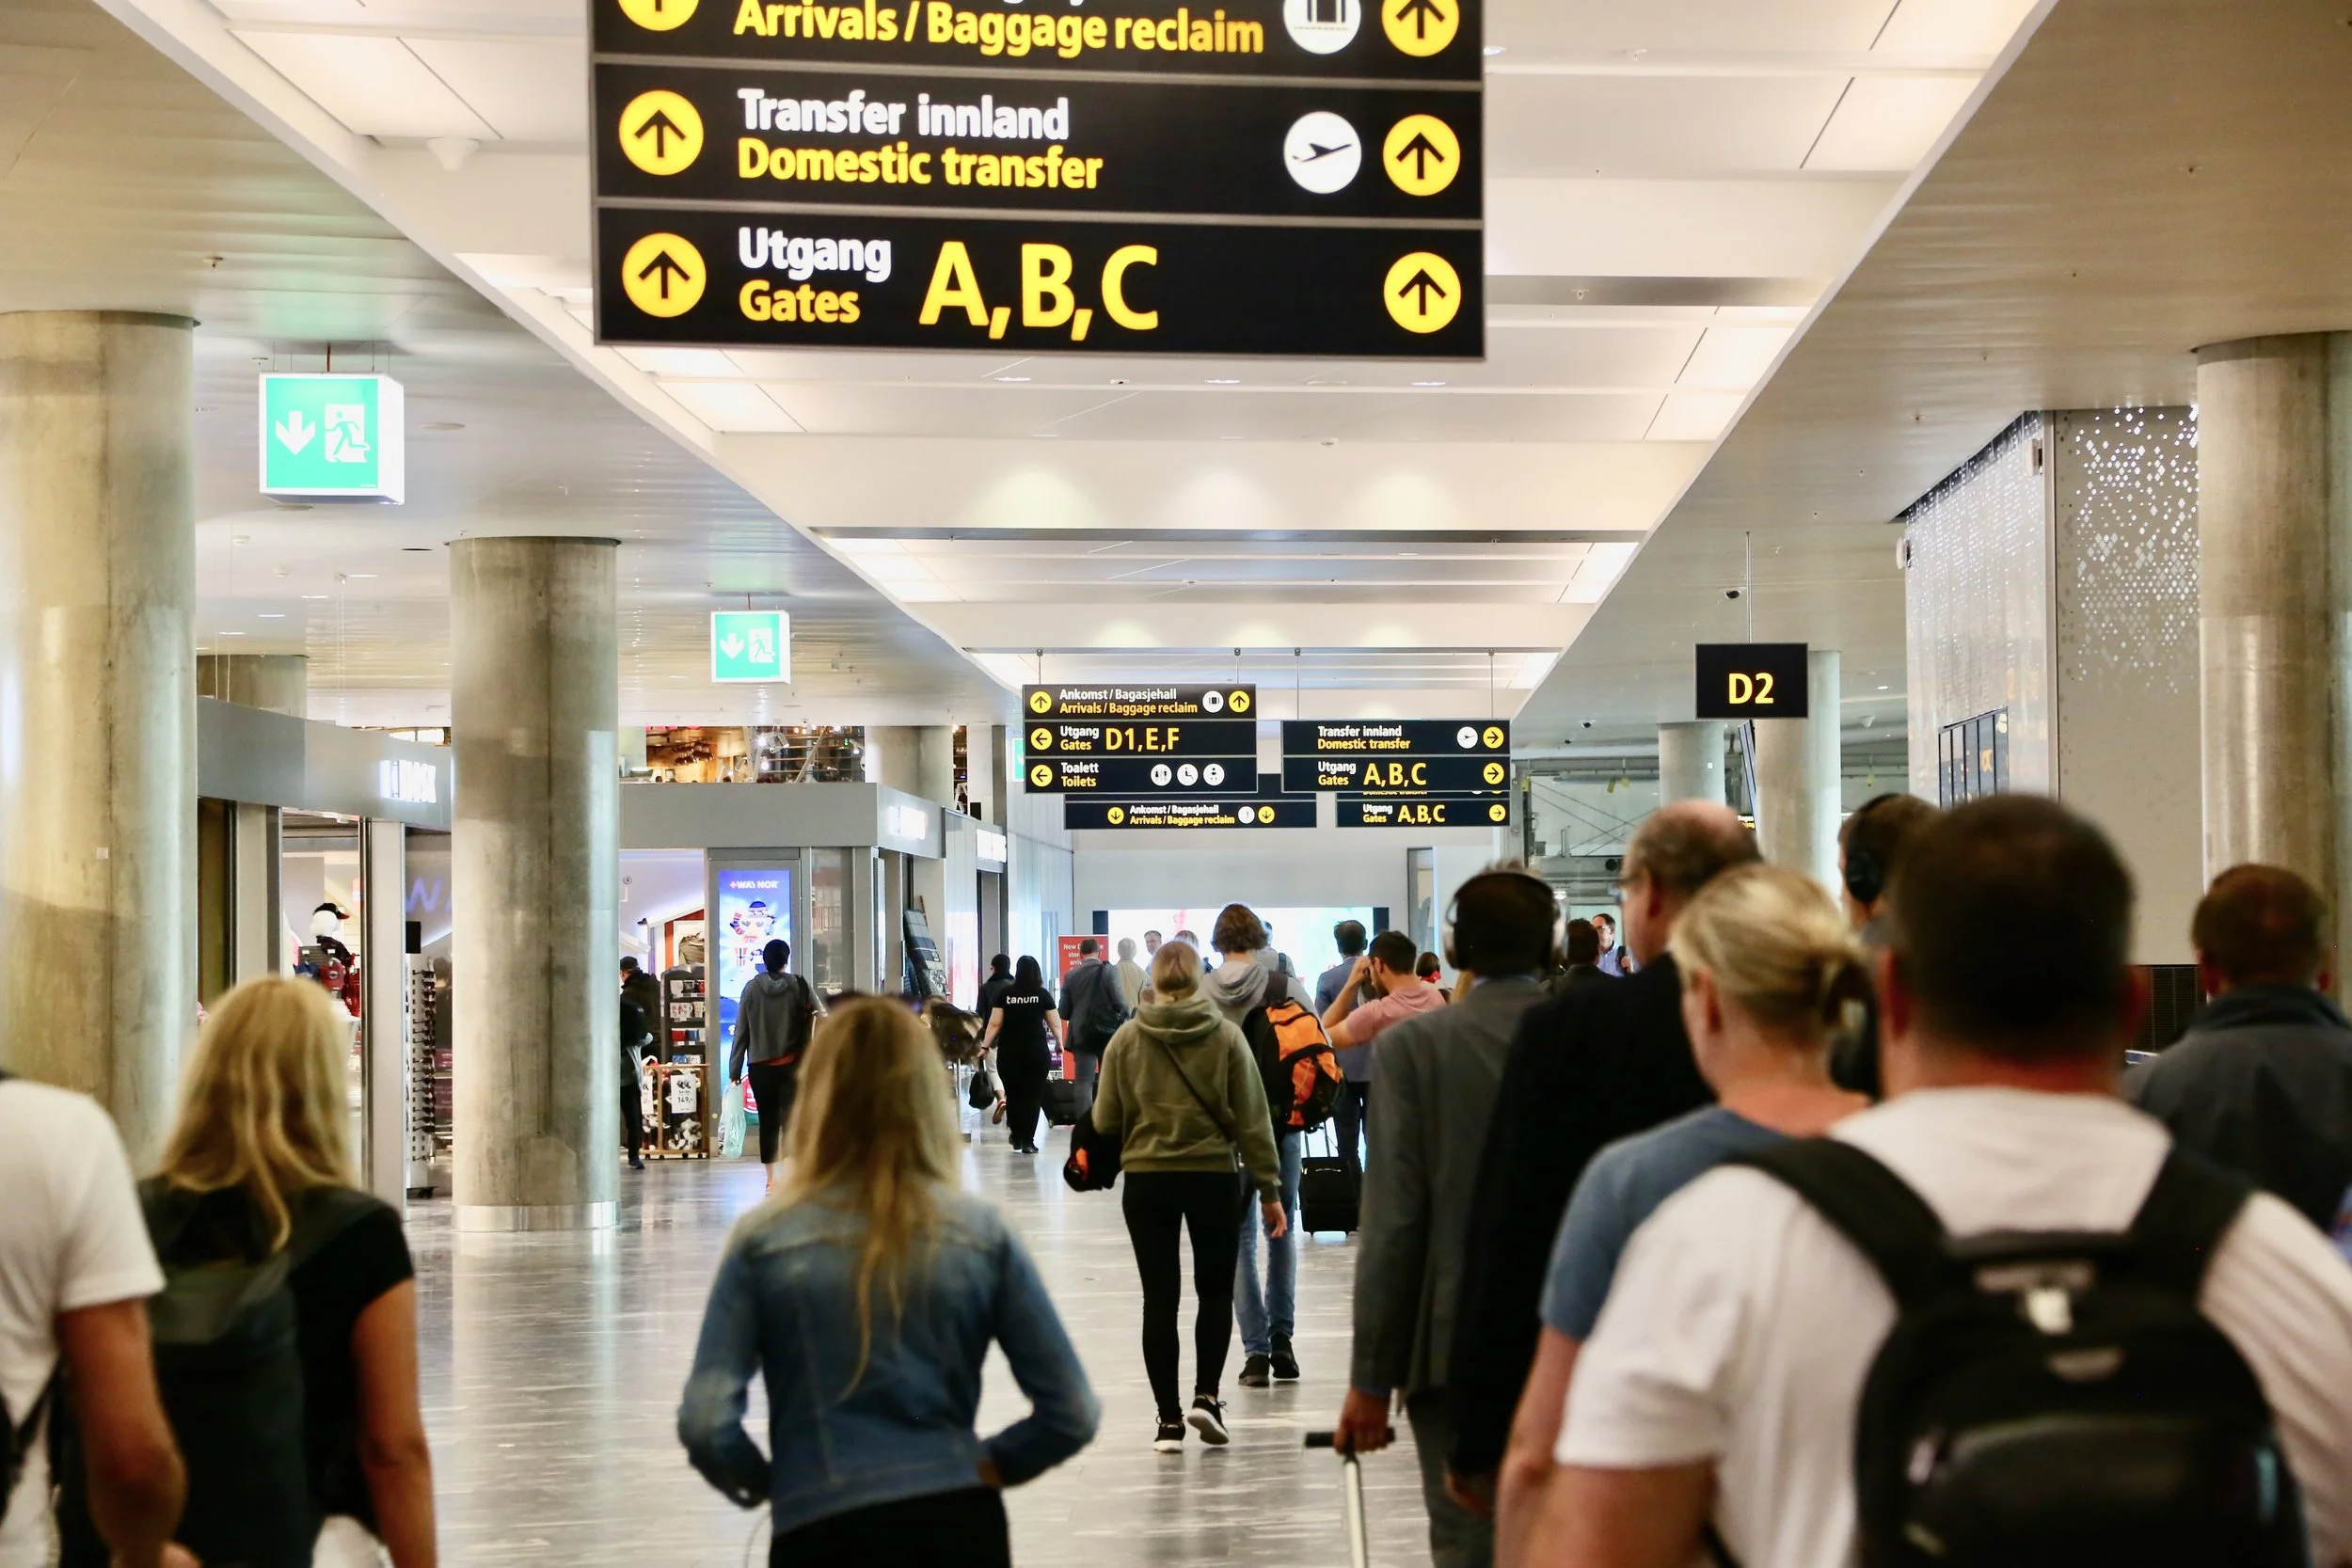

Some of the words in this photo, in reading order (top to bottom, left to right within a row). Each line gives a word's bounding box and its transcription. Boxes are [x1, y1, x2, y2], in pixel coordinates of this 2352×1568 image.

[733, 0, 898, 41] Arrivals
[928, 1, 1107, 59] Baggage
[1115, 8, 1263, 54] reclaim
[738, 88, 906, 135] Transfer
[918, 93, 1069, 139] innland
[738, 137, 931, 184] Domestic
[941, 145, 1104, 189] transfer
[738, 227, 892, 283] Utgang
[739, 279, 861, 324] Gates
[1059, 689, 1108, 701] Ankomst
[1115, 688, 1177, 703] Bagasjehall
[1728, 673, 1774, 705] D2
[1059, 702, 1102, 714] Arrivals
[1109, 703, 1156, 716] Baggage
[1158, 702, 1198, 713] reclaim
[1059, 725, 1100, 739] Utgang
[1317, 725, 1360, 737] Transfer
[1362, 725, 1403, 737] innland
[1059, 739, 1092, 751] Gates
[1317, 737, 1367, 750] Domestic
[1369, 737, 1411, 750] transfer
[1060, 762, 1100, 774] Toalett
[1317, 761, 1357, 775] Utgang
[1060, 775, 1097, 787] Toilets
[1318, 774, 1349, 785] Gates
[1129, 805, 1167, 815] Ankomst
[1171, 804, 1219, 816] Bagasjehall
[1362, 803, 1393, 815] Utgang
[1130, 816, 1162, 825] Arrivals
[1167, 816, 1204, 827] Baggage
[1204, 815, 1235, 825] reclaim
[1362, 814, 1388, 823] Gates
[1006, 995, 1040, 1005] tanum
